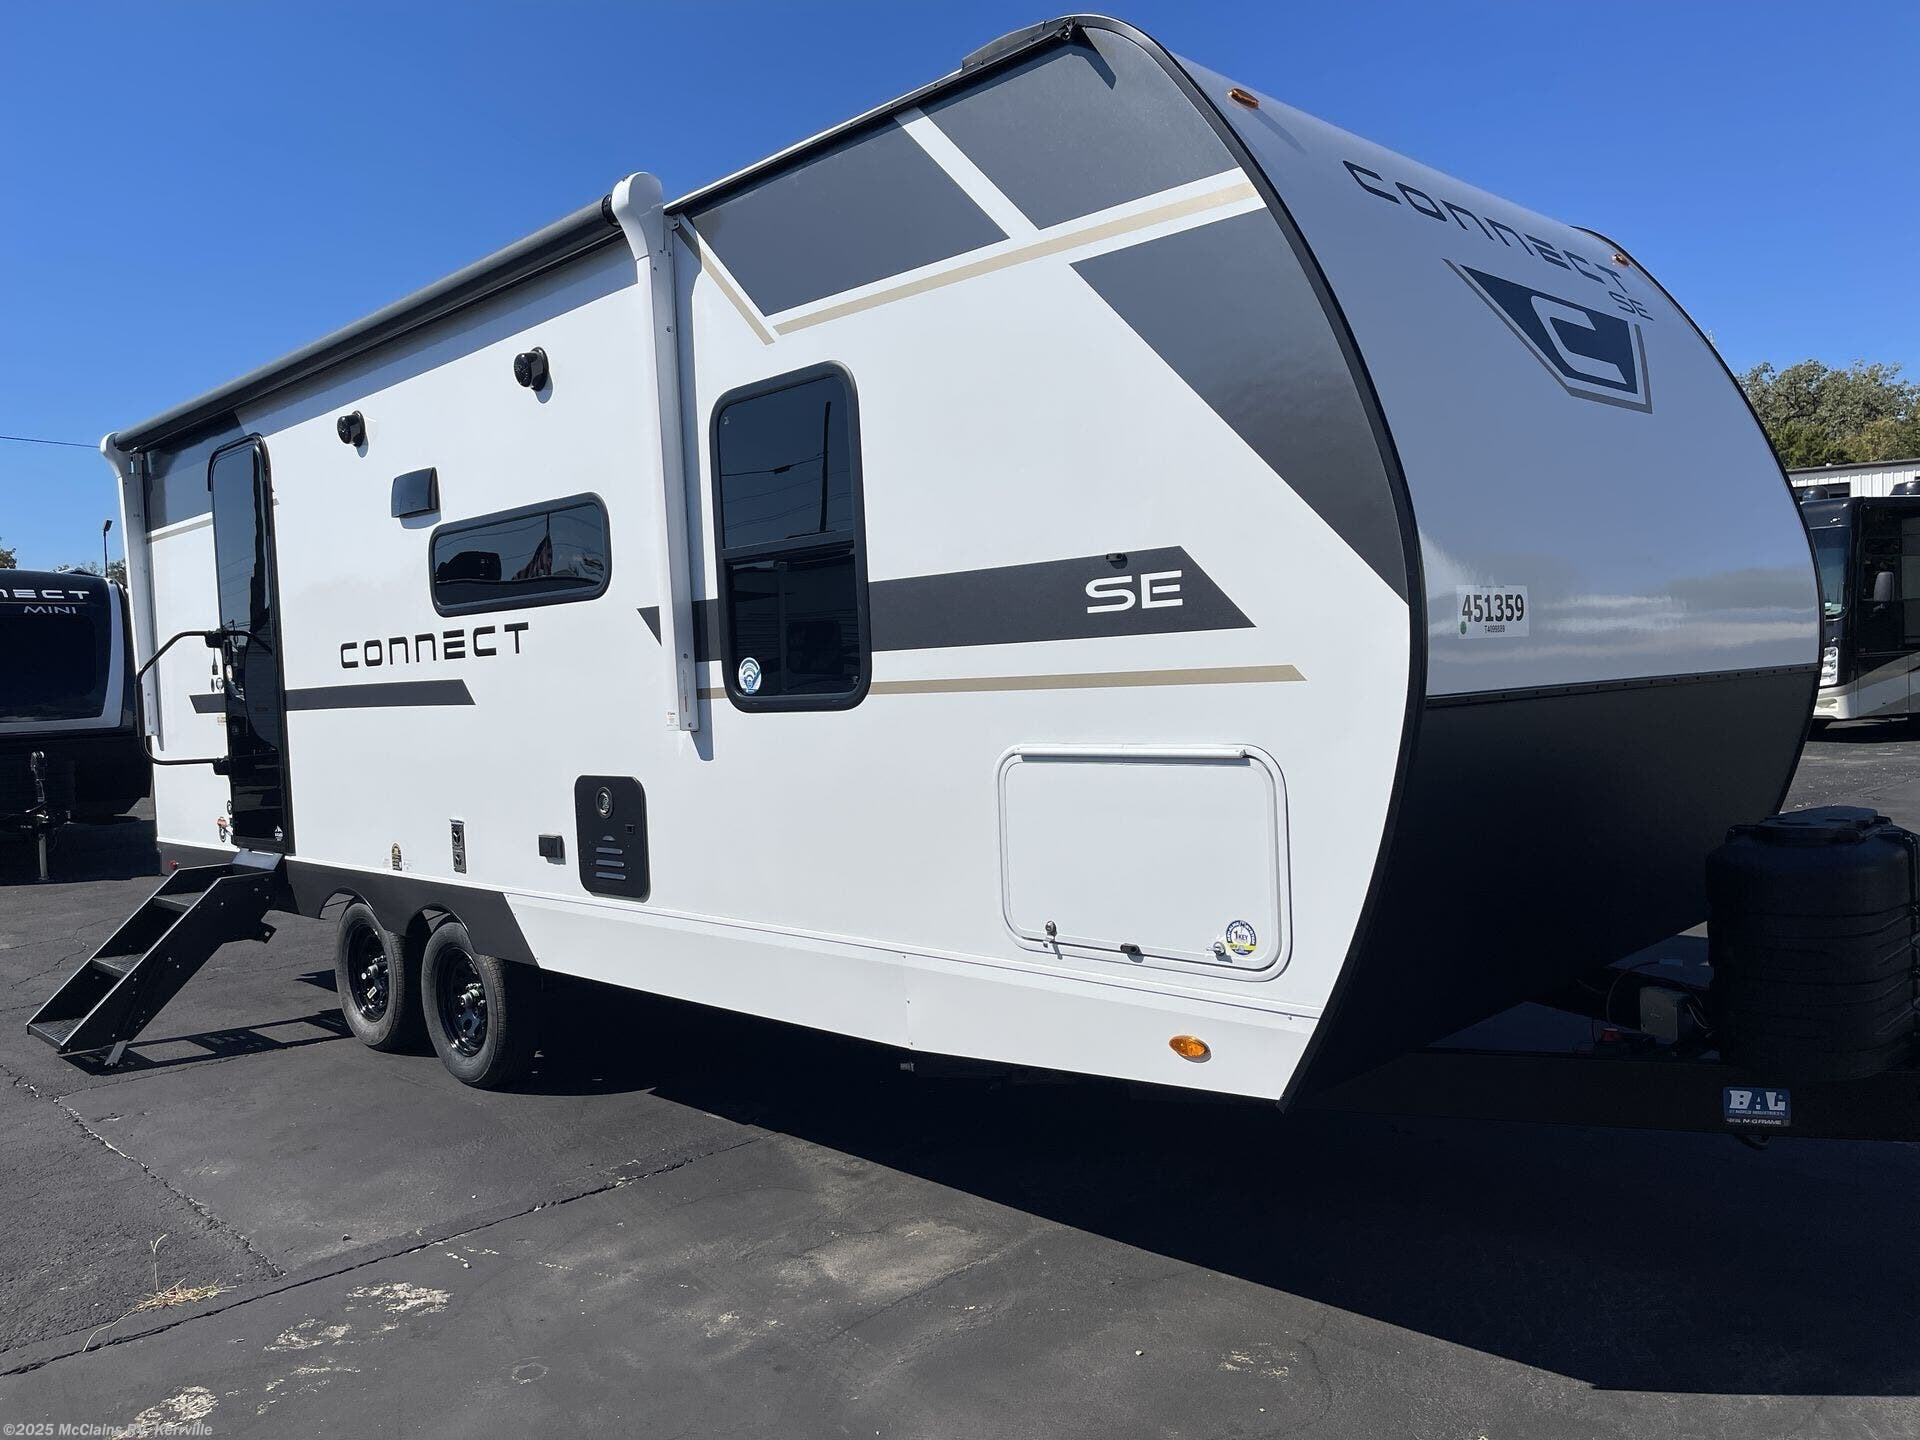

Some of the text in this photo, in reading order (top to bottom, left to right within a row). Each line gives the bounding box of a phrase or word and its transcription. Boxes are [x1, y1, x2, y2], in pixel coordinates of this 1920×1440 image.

[1342, 159, 1629, 294] CONNECT
[1608, 290, 1655, 322] SE
[23, 605, 77, 614] MINI
[1085, 569, 1184, 614] SE
[1461, 593, 1525, 623] 451359
[340, 621, 529, 669] CONNECT
